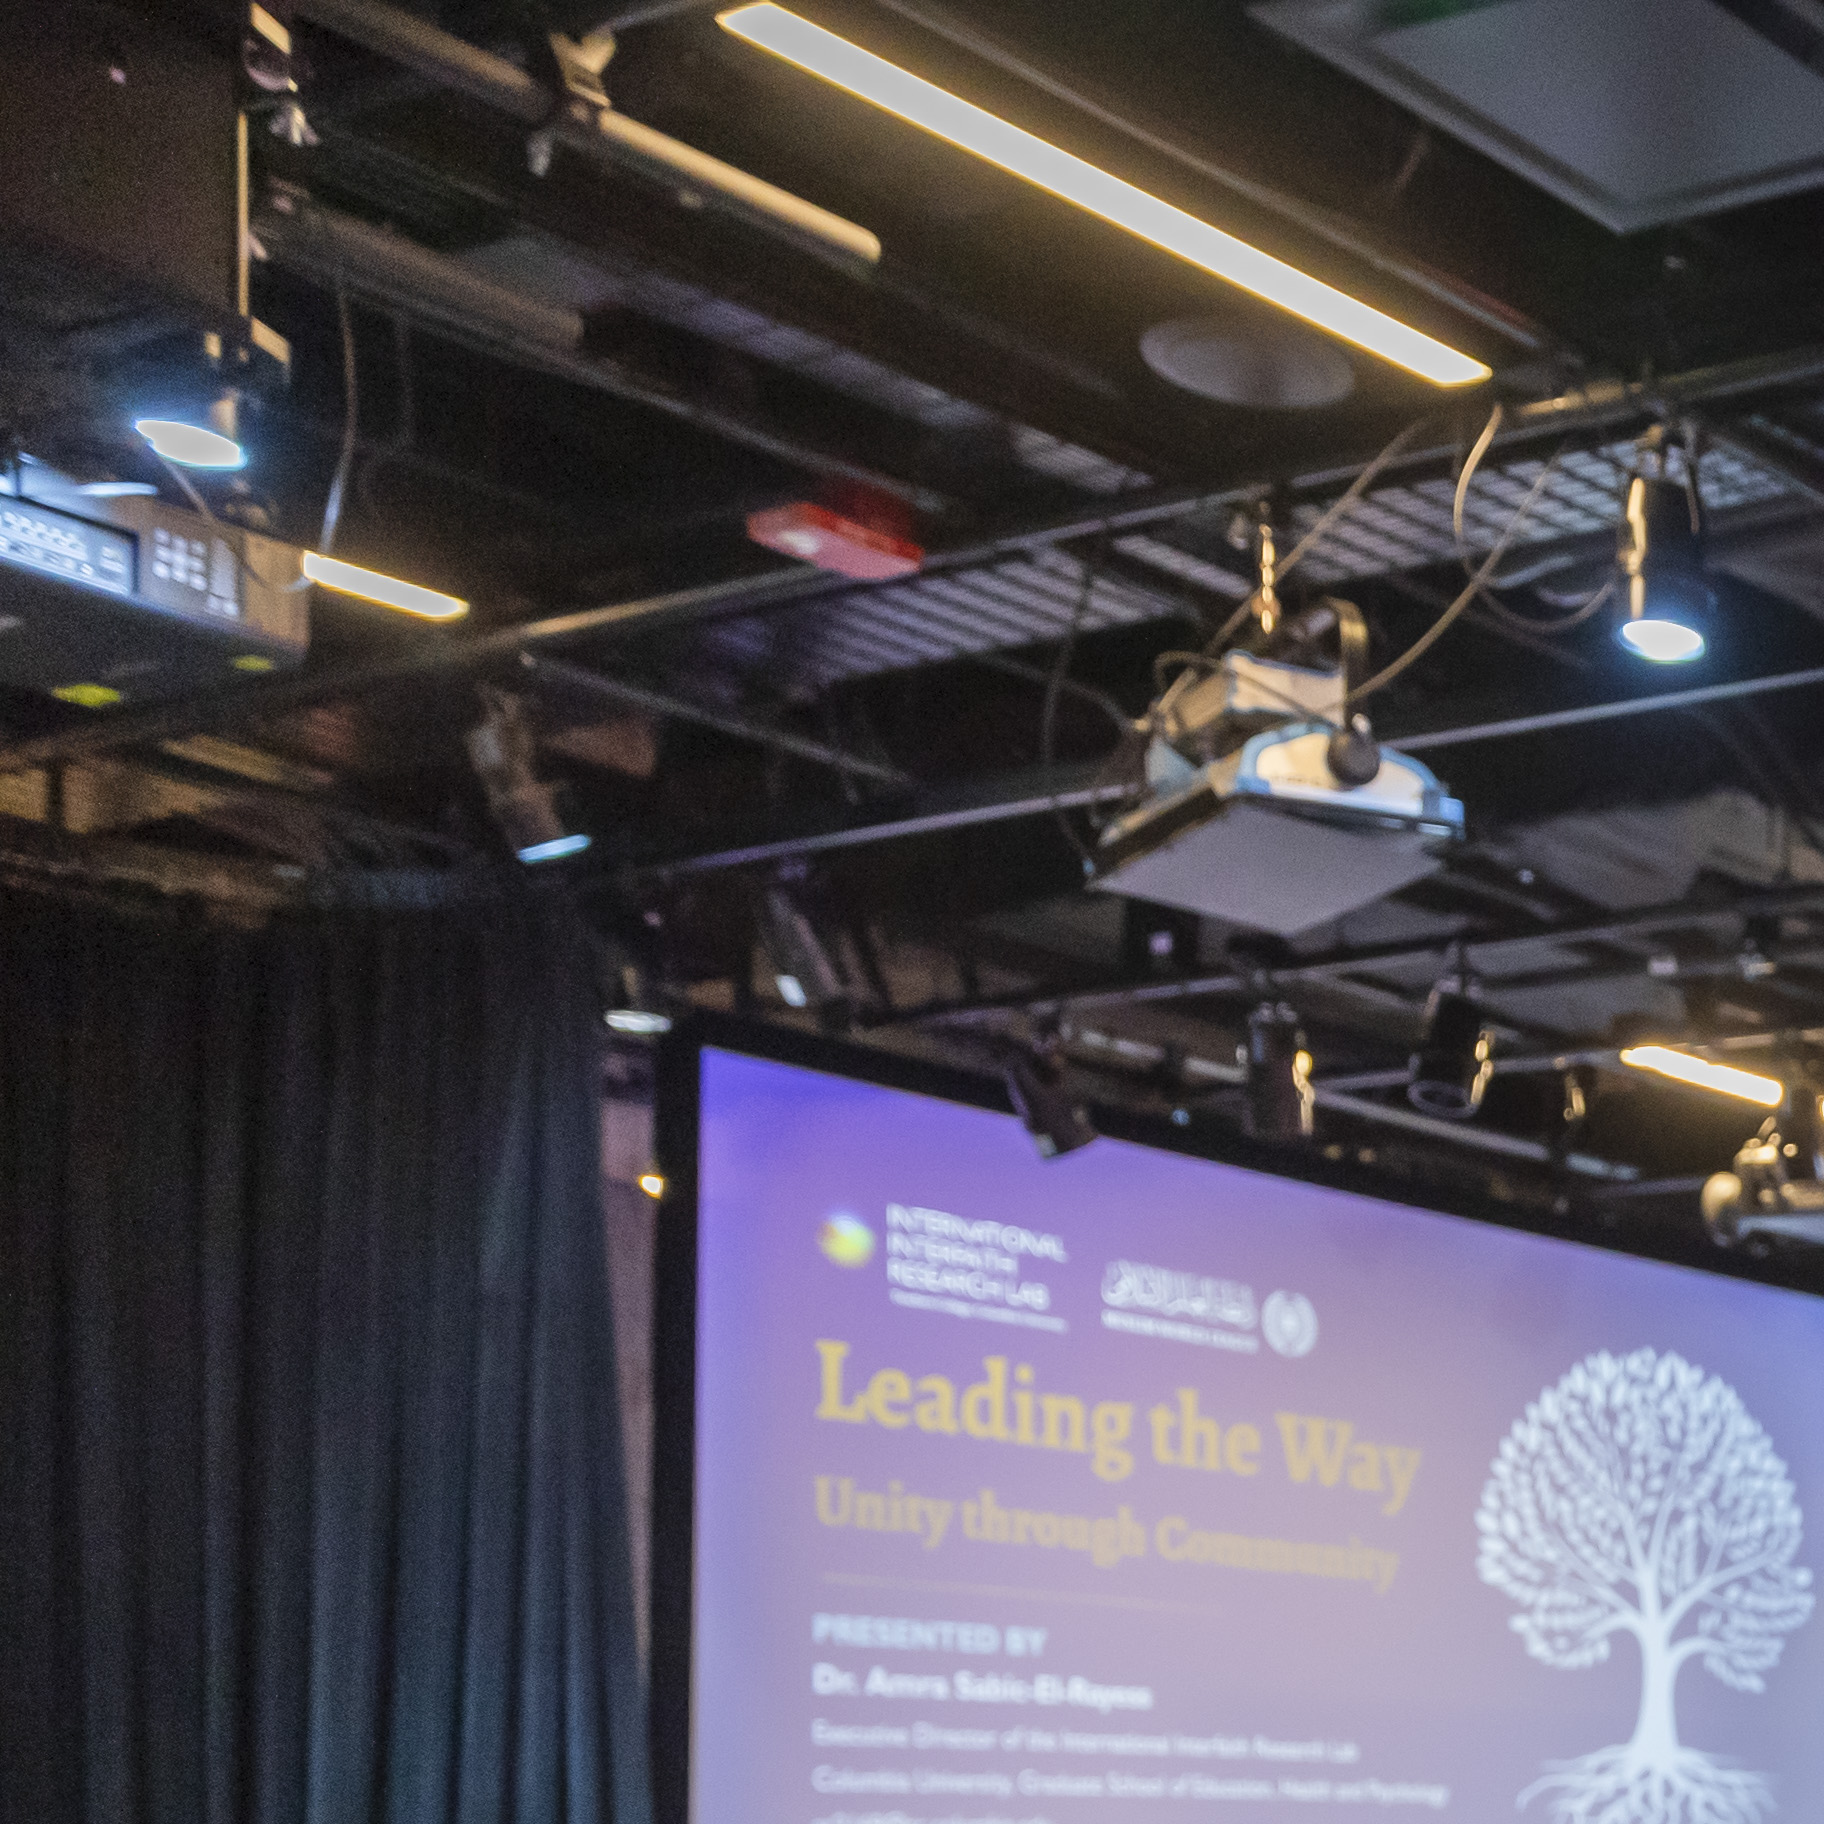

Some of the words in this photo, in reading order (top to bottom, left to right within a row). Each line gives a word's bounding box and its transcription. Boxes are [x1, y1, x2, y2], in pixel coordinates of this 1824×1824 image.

[886, 1203, 1070, 1263] INTERNATIONAL
[813, 1338, 1135, 1481] Leading
[1148, 1387, 1262, 1477] the
[1273, 1410, 1423, 1517] Way
[813, 1474, 953, 1550] Unity
[960, 1487, 1147, 1568] through
[1154, 1513, 1402, 1594] Community
[812, 1613, 1000, 1655] PRESENTED
[1005, 1625, 1047, 1657] BY
[812, 1662, 857, 1697] Dr.
[864, 1665, 949, 1699] Amra
